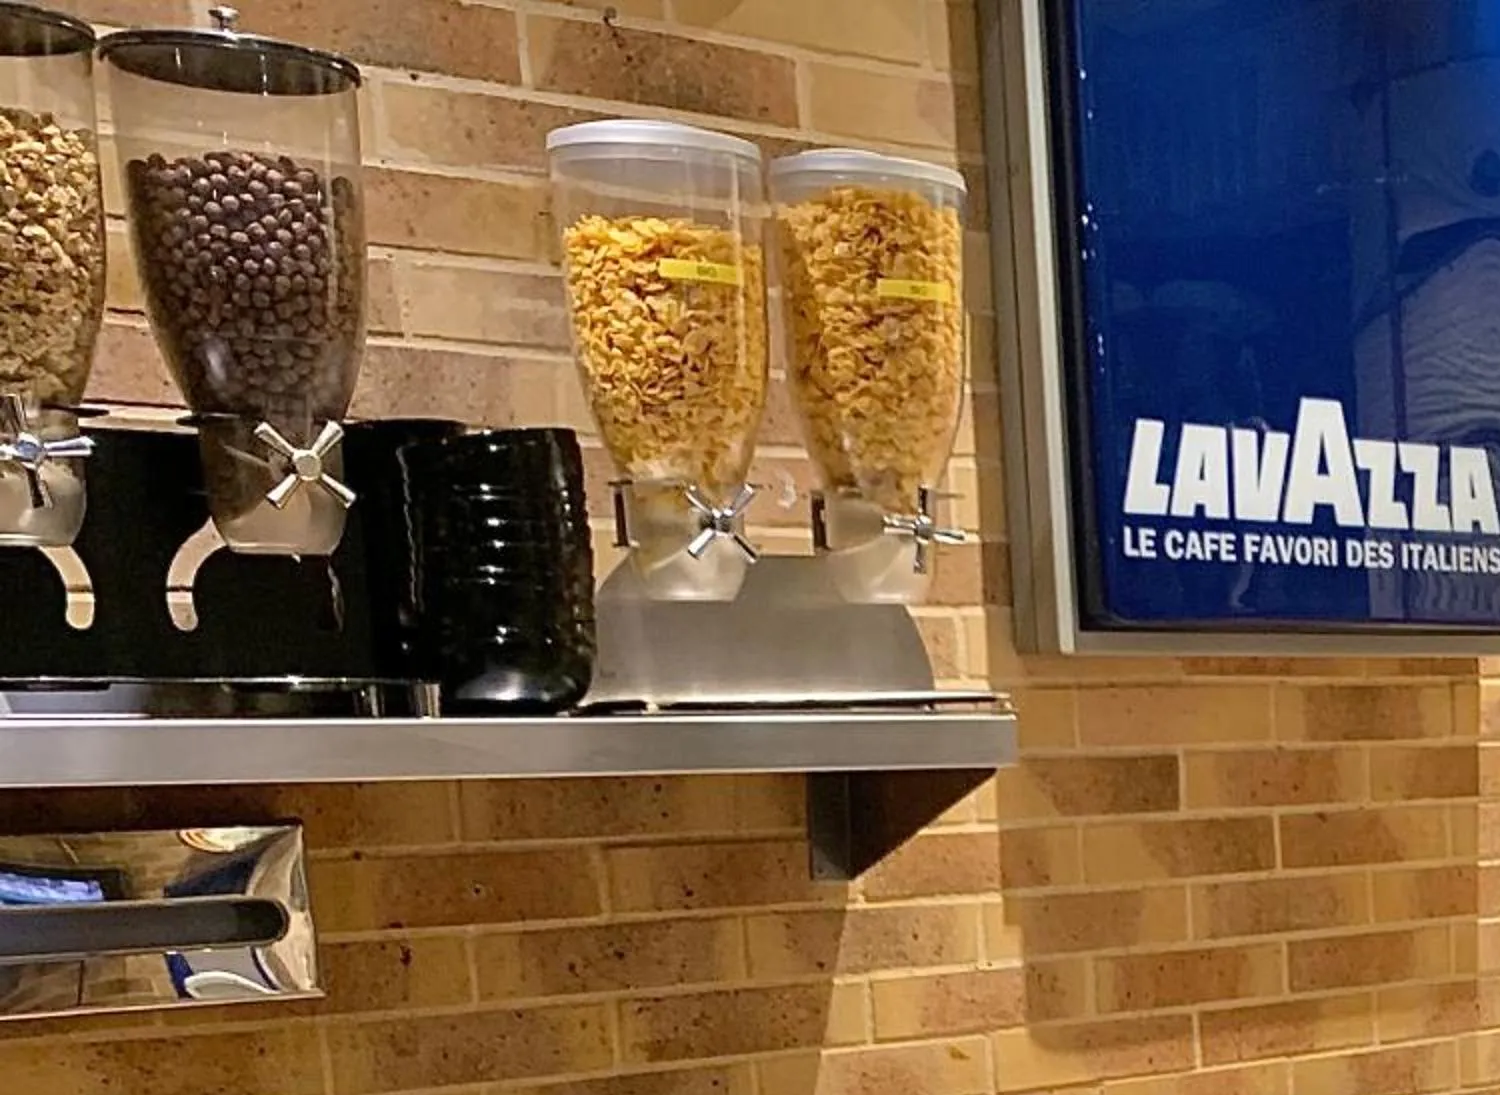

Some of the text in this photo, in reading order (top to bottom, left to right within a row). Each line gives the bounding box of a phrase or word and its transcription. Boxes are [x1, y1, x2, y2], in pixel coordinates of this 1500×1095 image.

[1123, 396, 1500, 535] LAVAZZA
[1123, 526, 1157, 558] LE
[1164, 529, 1237, 562] CAFE
[1243, 533, 1338, 568] FAVORI
[1346, 539, 1394, 570] DES
